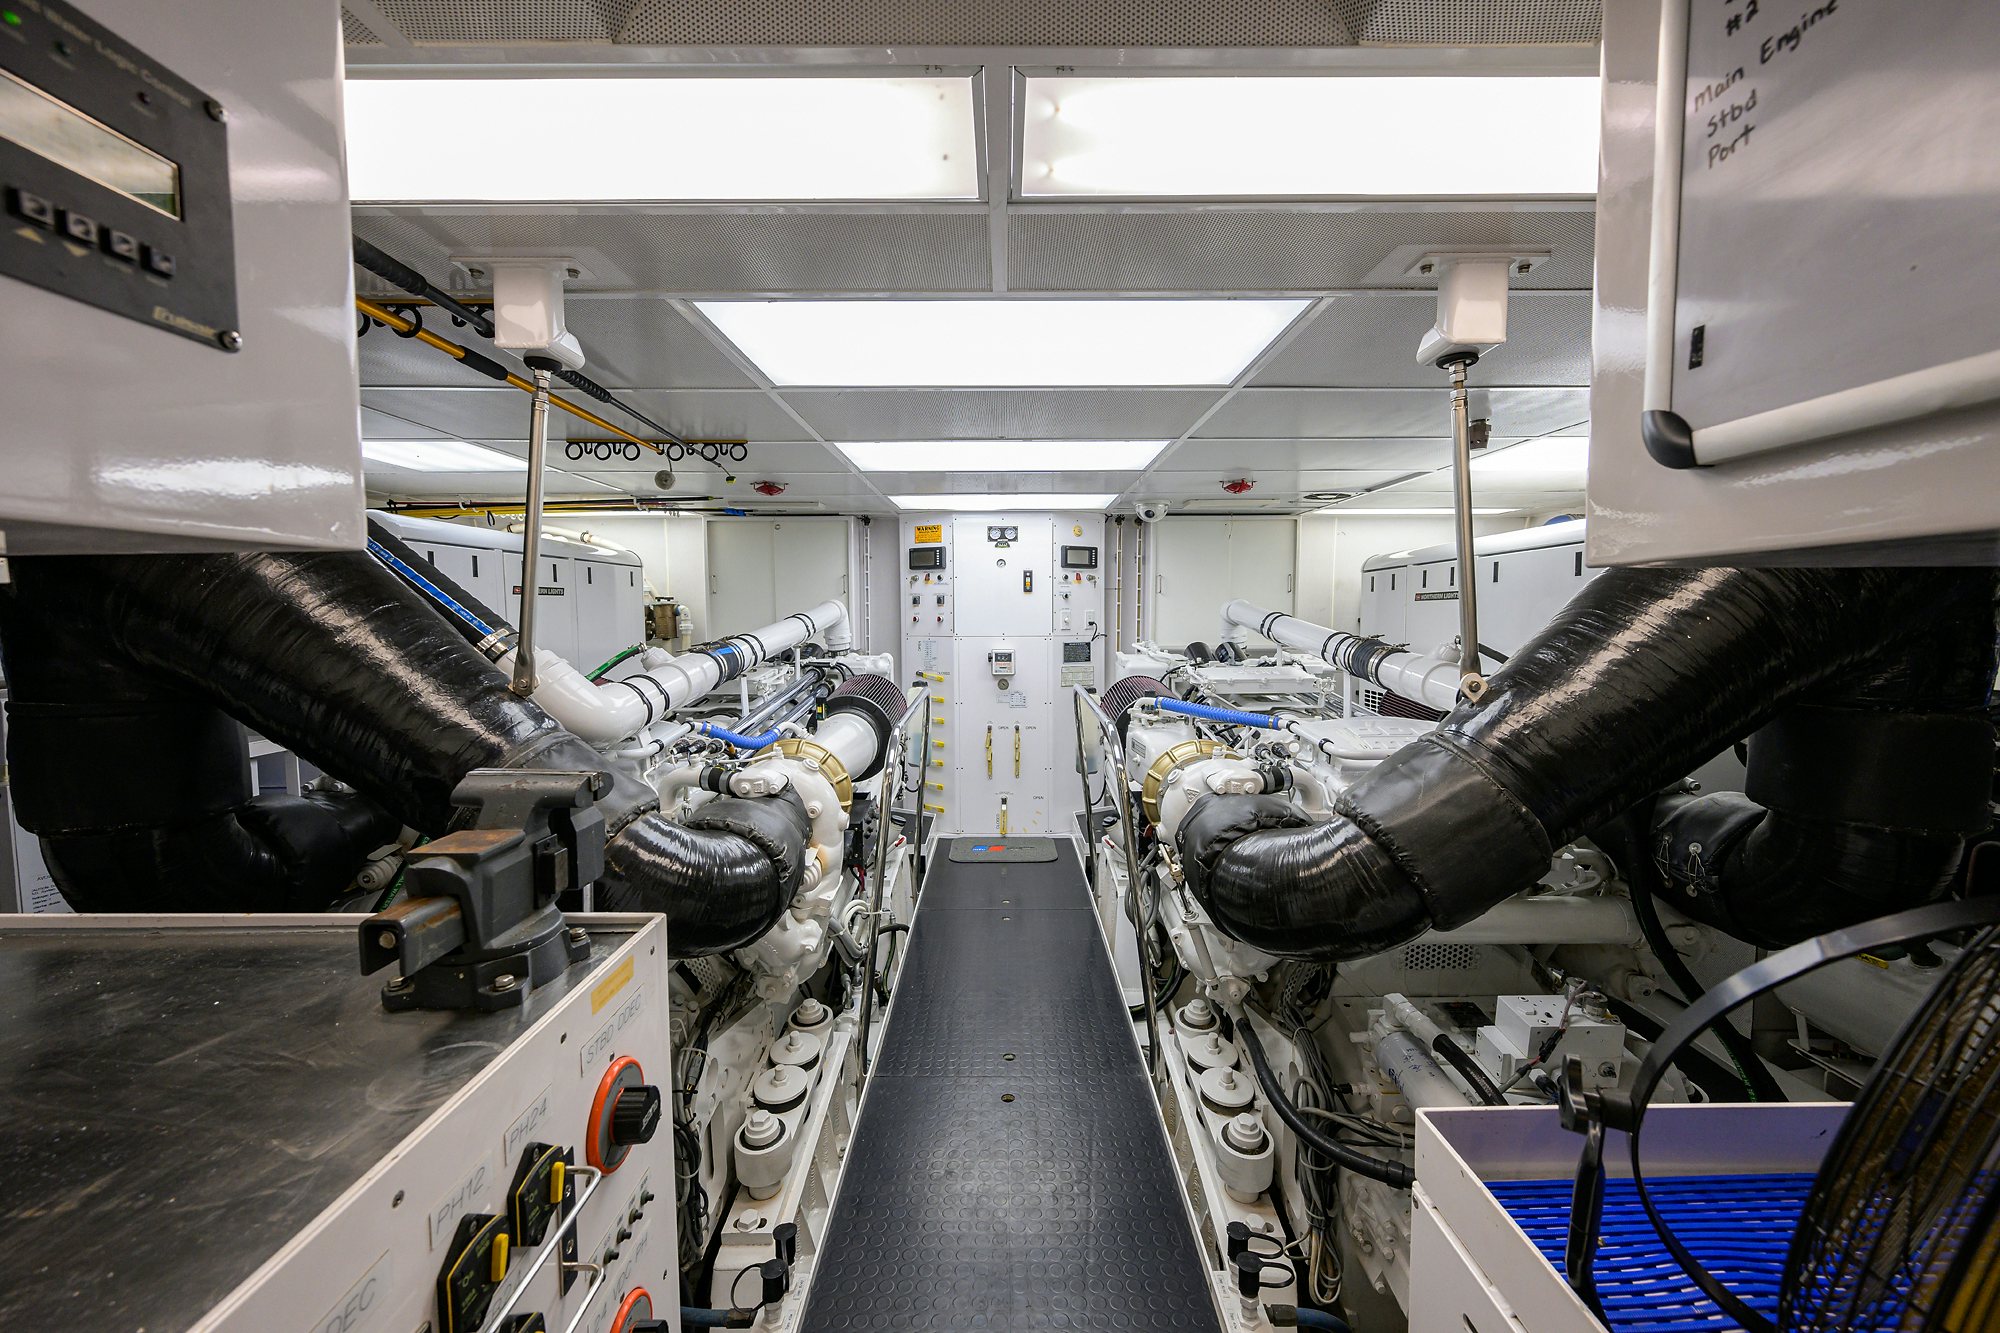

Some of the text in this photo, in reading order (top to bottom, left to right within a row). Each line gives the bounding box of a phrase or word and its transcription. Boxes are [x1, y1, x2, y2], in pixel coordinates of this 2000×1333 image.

[1708, 124, 1756, 170] Port
[586, 1024, 614, 1064] STBD
[510, 1097, 547, 1151] PH24
[436, 1166, 486, 1234] PH12
